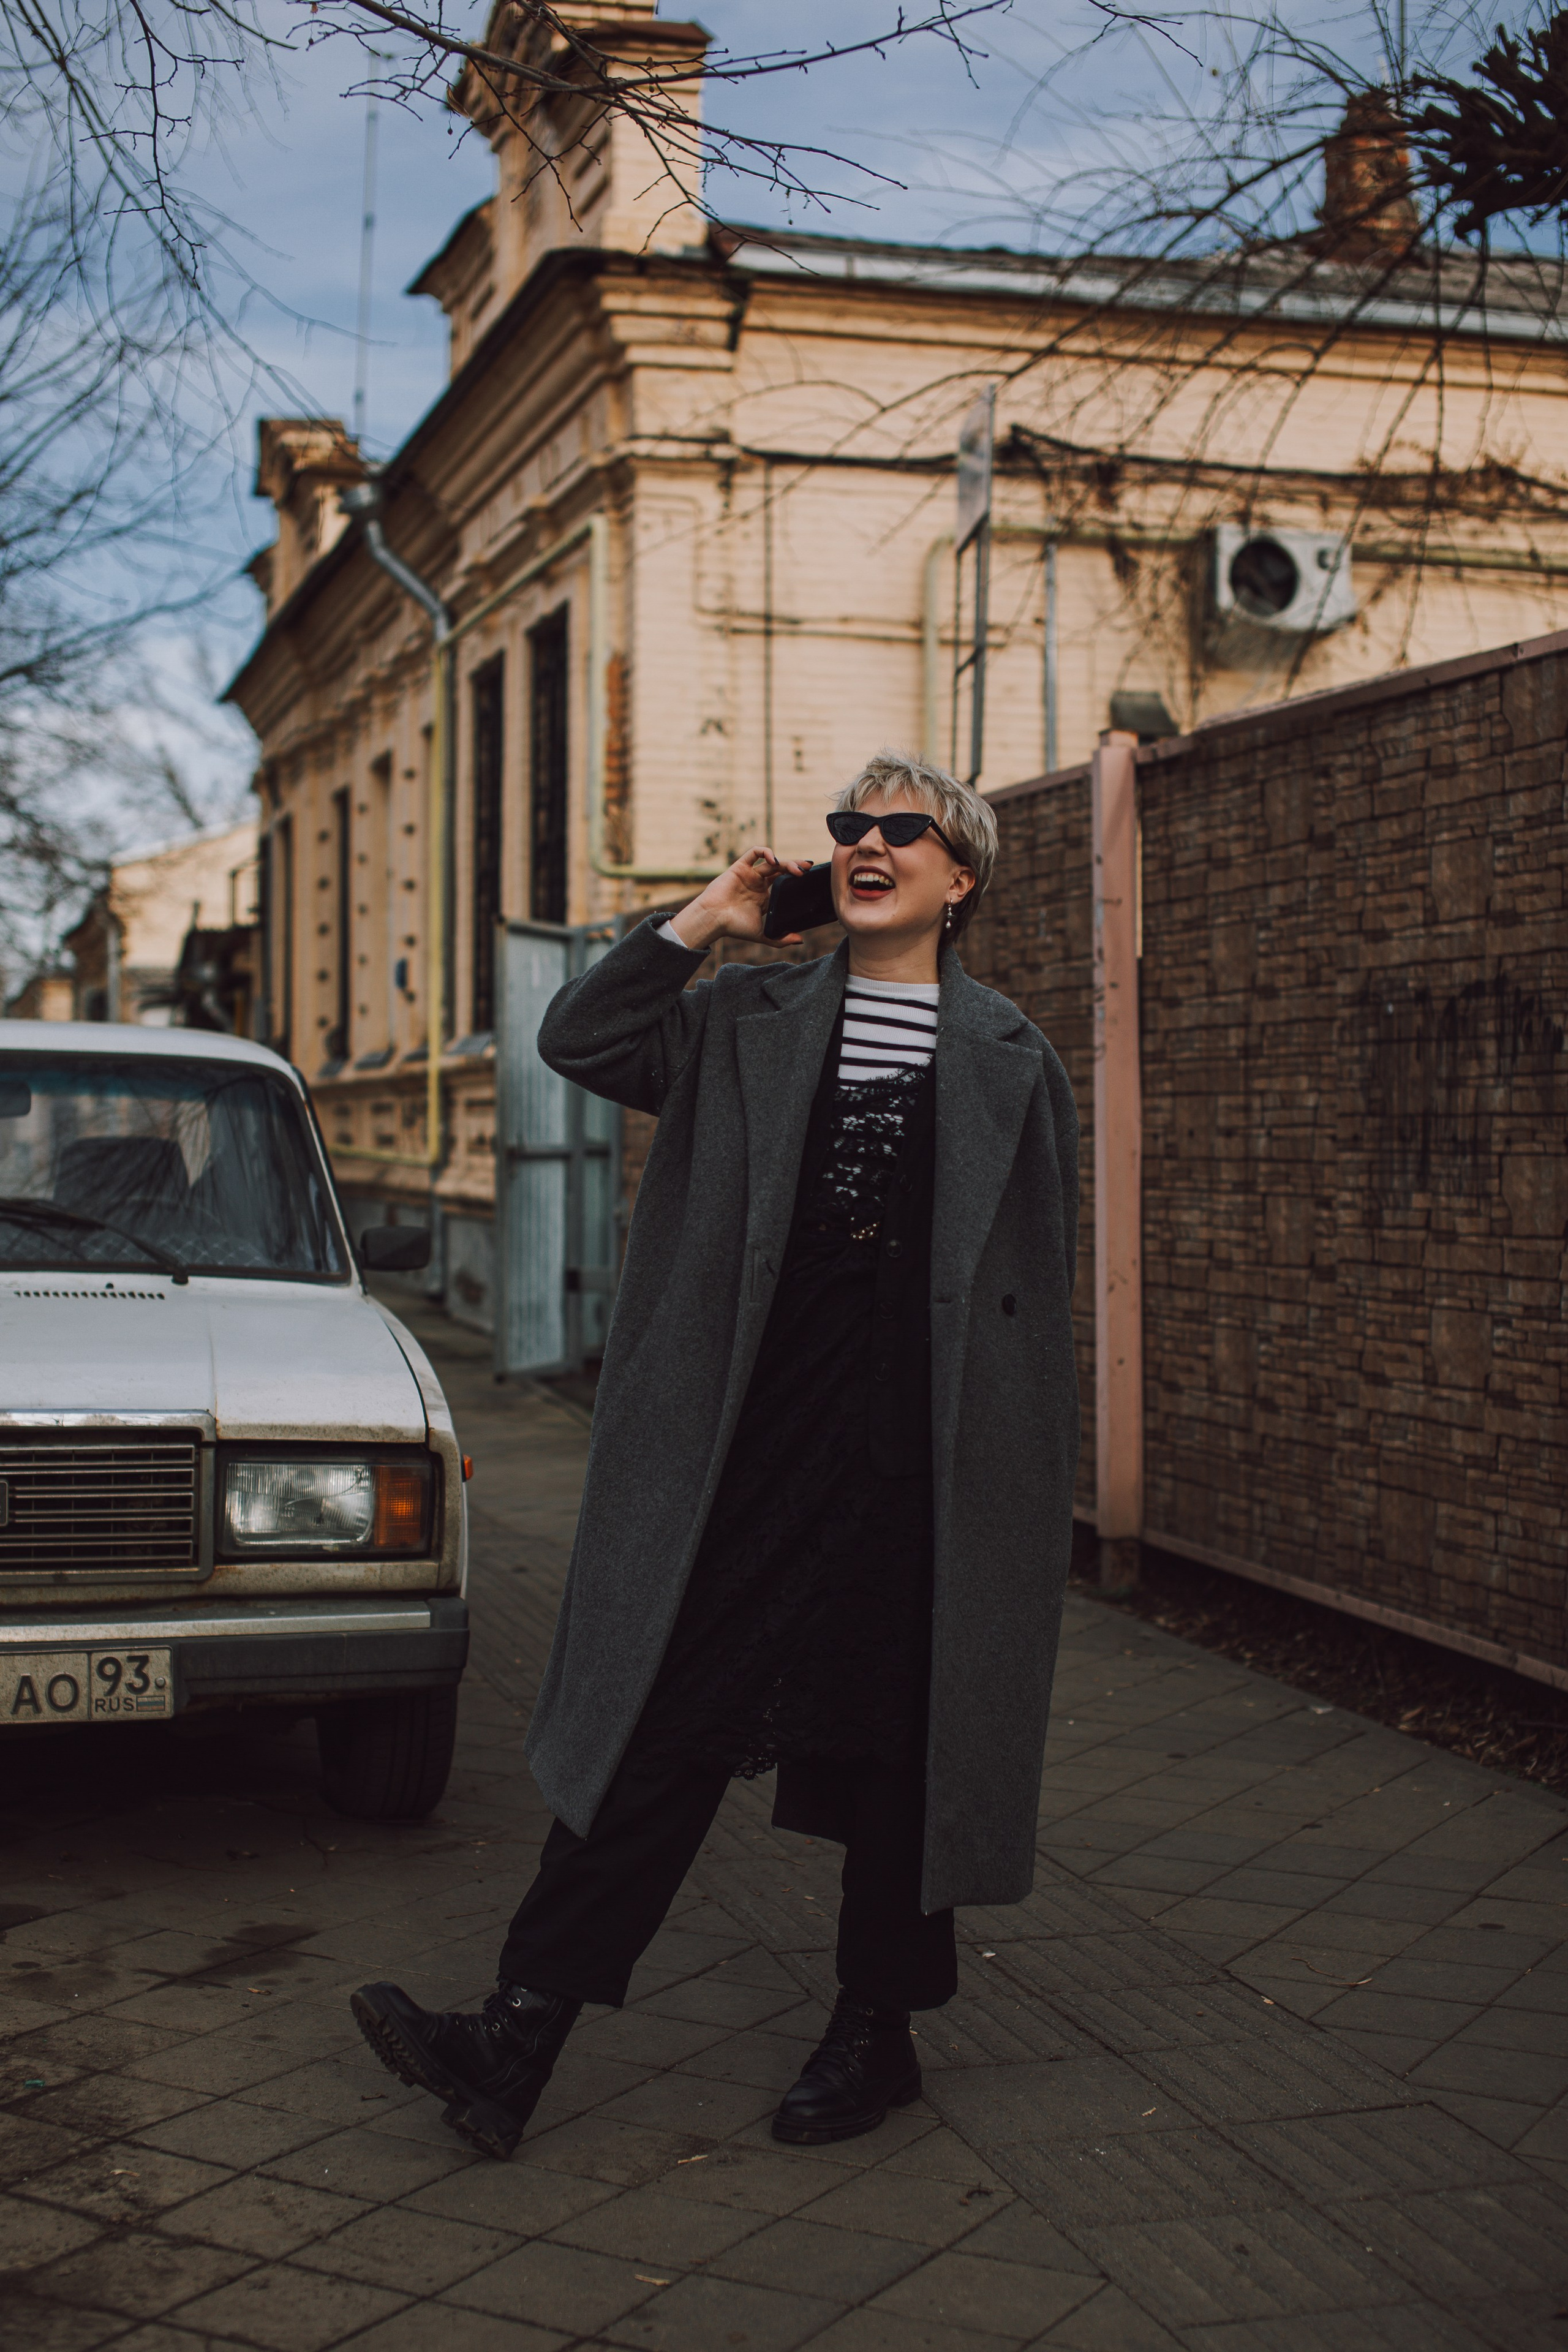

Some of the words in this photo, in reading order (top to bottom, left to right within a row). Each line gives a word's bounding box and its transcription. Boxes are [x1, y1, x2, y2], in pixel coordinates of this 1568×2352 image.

[11, 1673, 79, 1714] AO
[97, 1655, 150, 1696] 93
[95, 1697, 134, 1713] RUS
